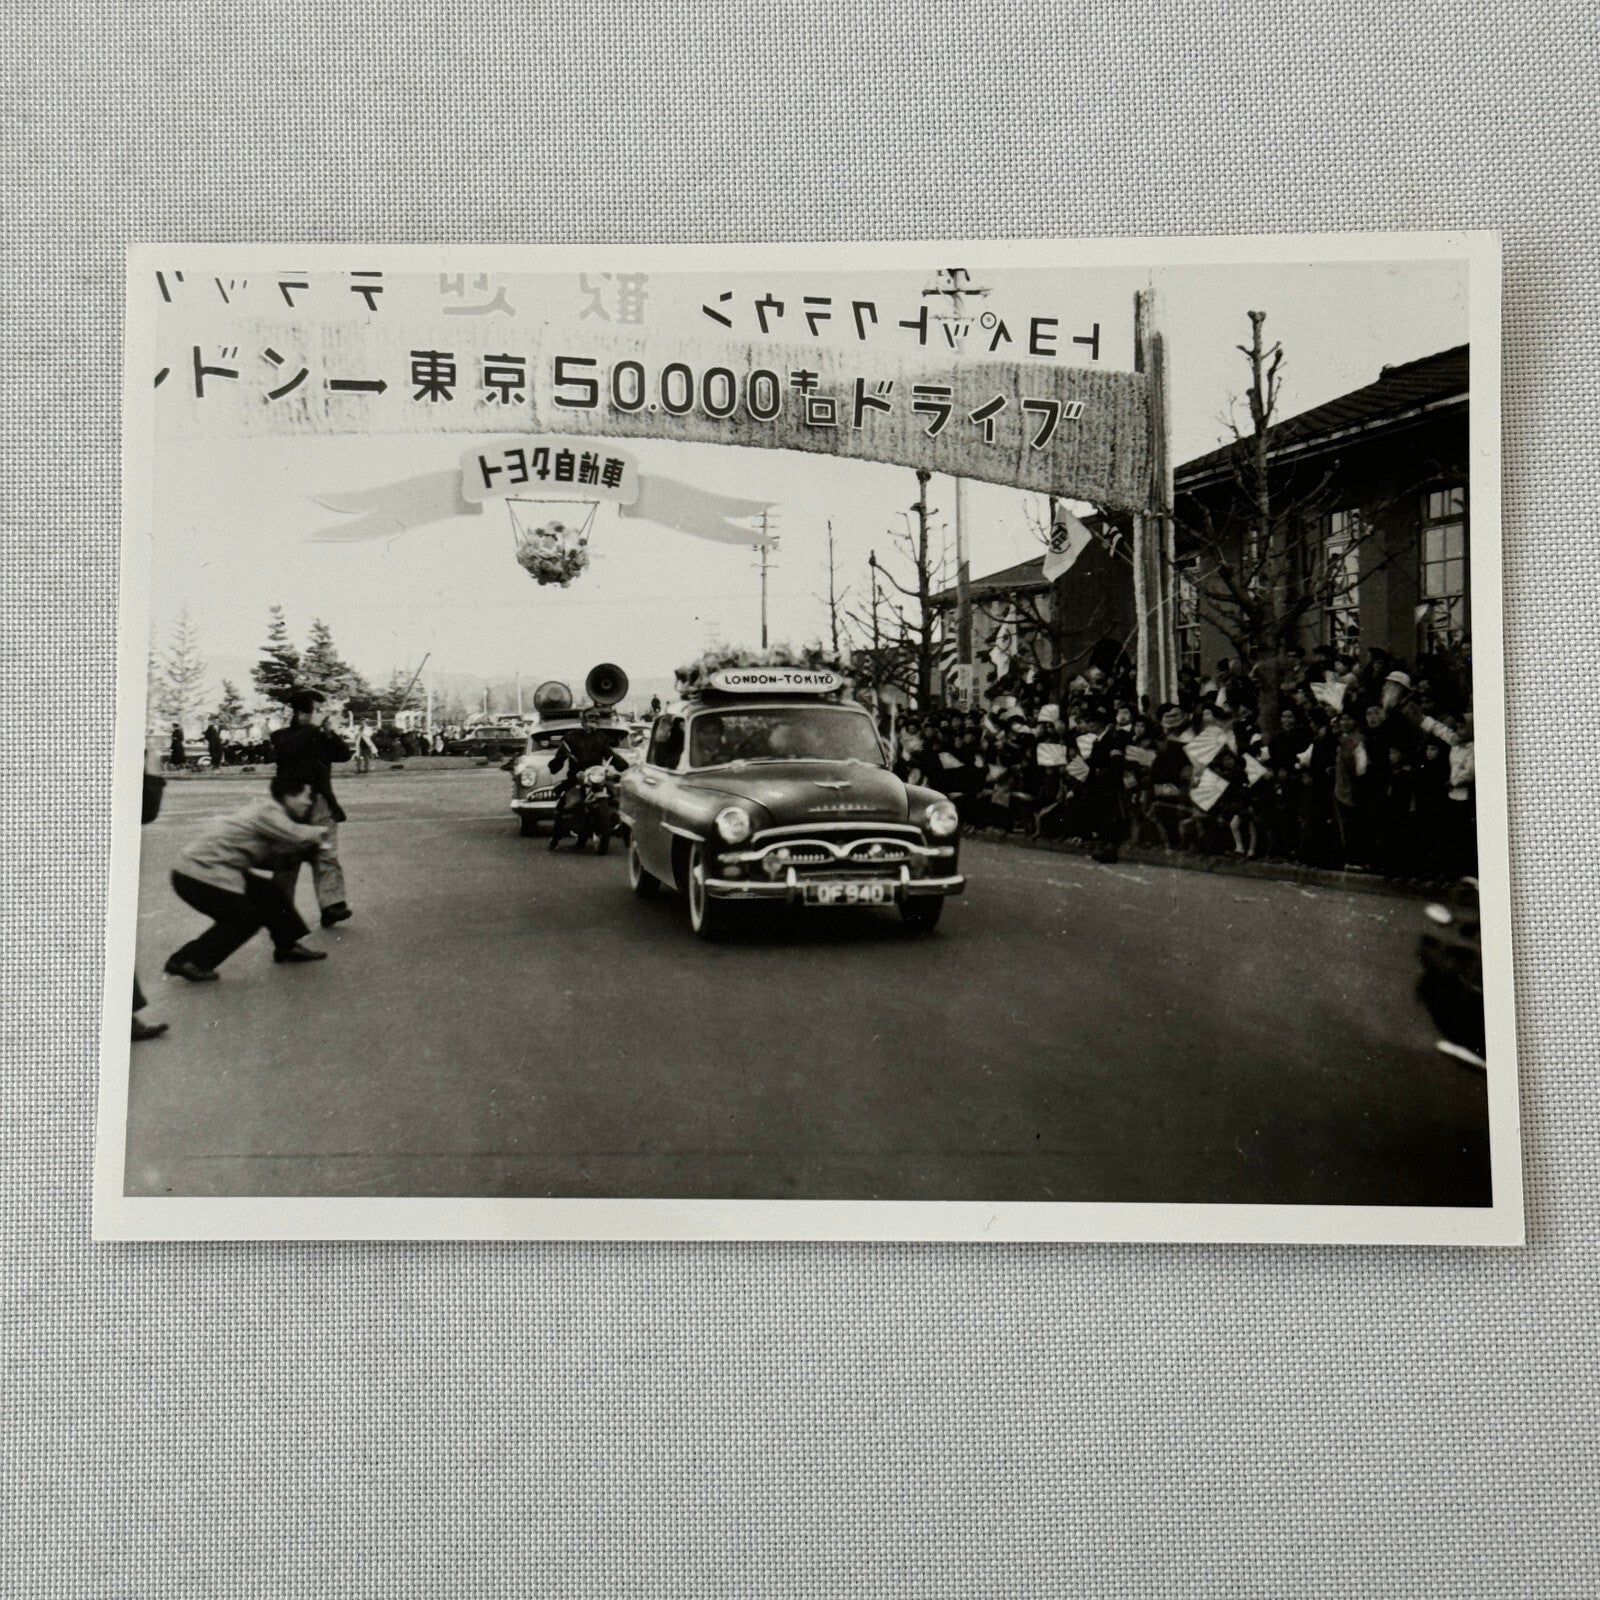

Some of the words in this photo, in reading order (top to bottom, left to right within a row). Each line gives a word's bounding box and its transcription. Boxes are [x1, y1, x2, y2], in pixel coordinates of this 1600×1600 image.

[478, 447, 625, 488] トヨタ自動車
